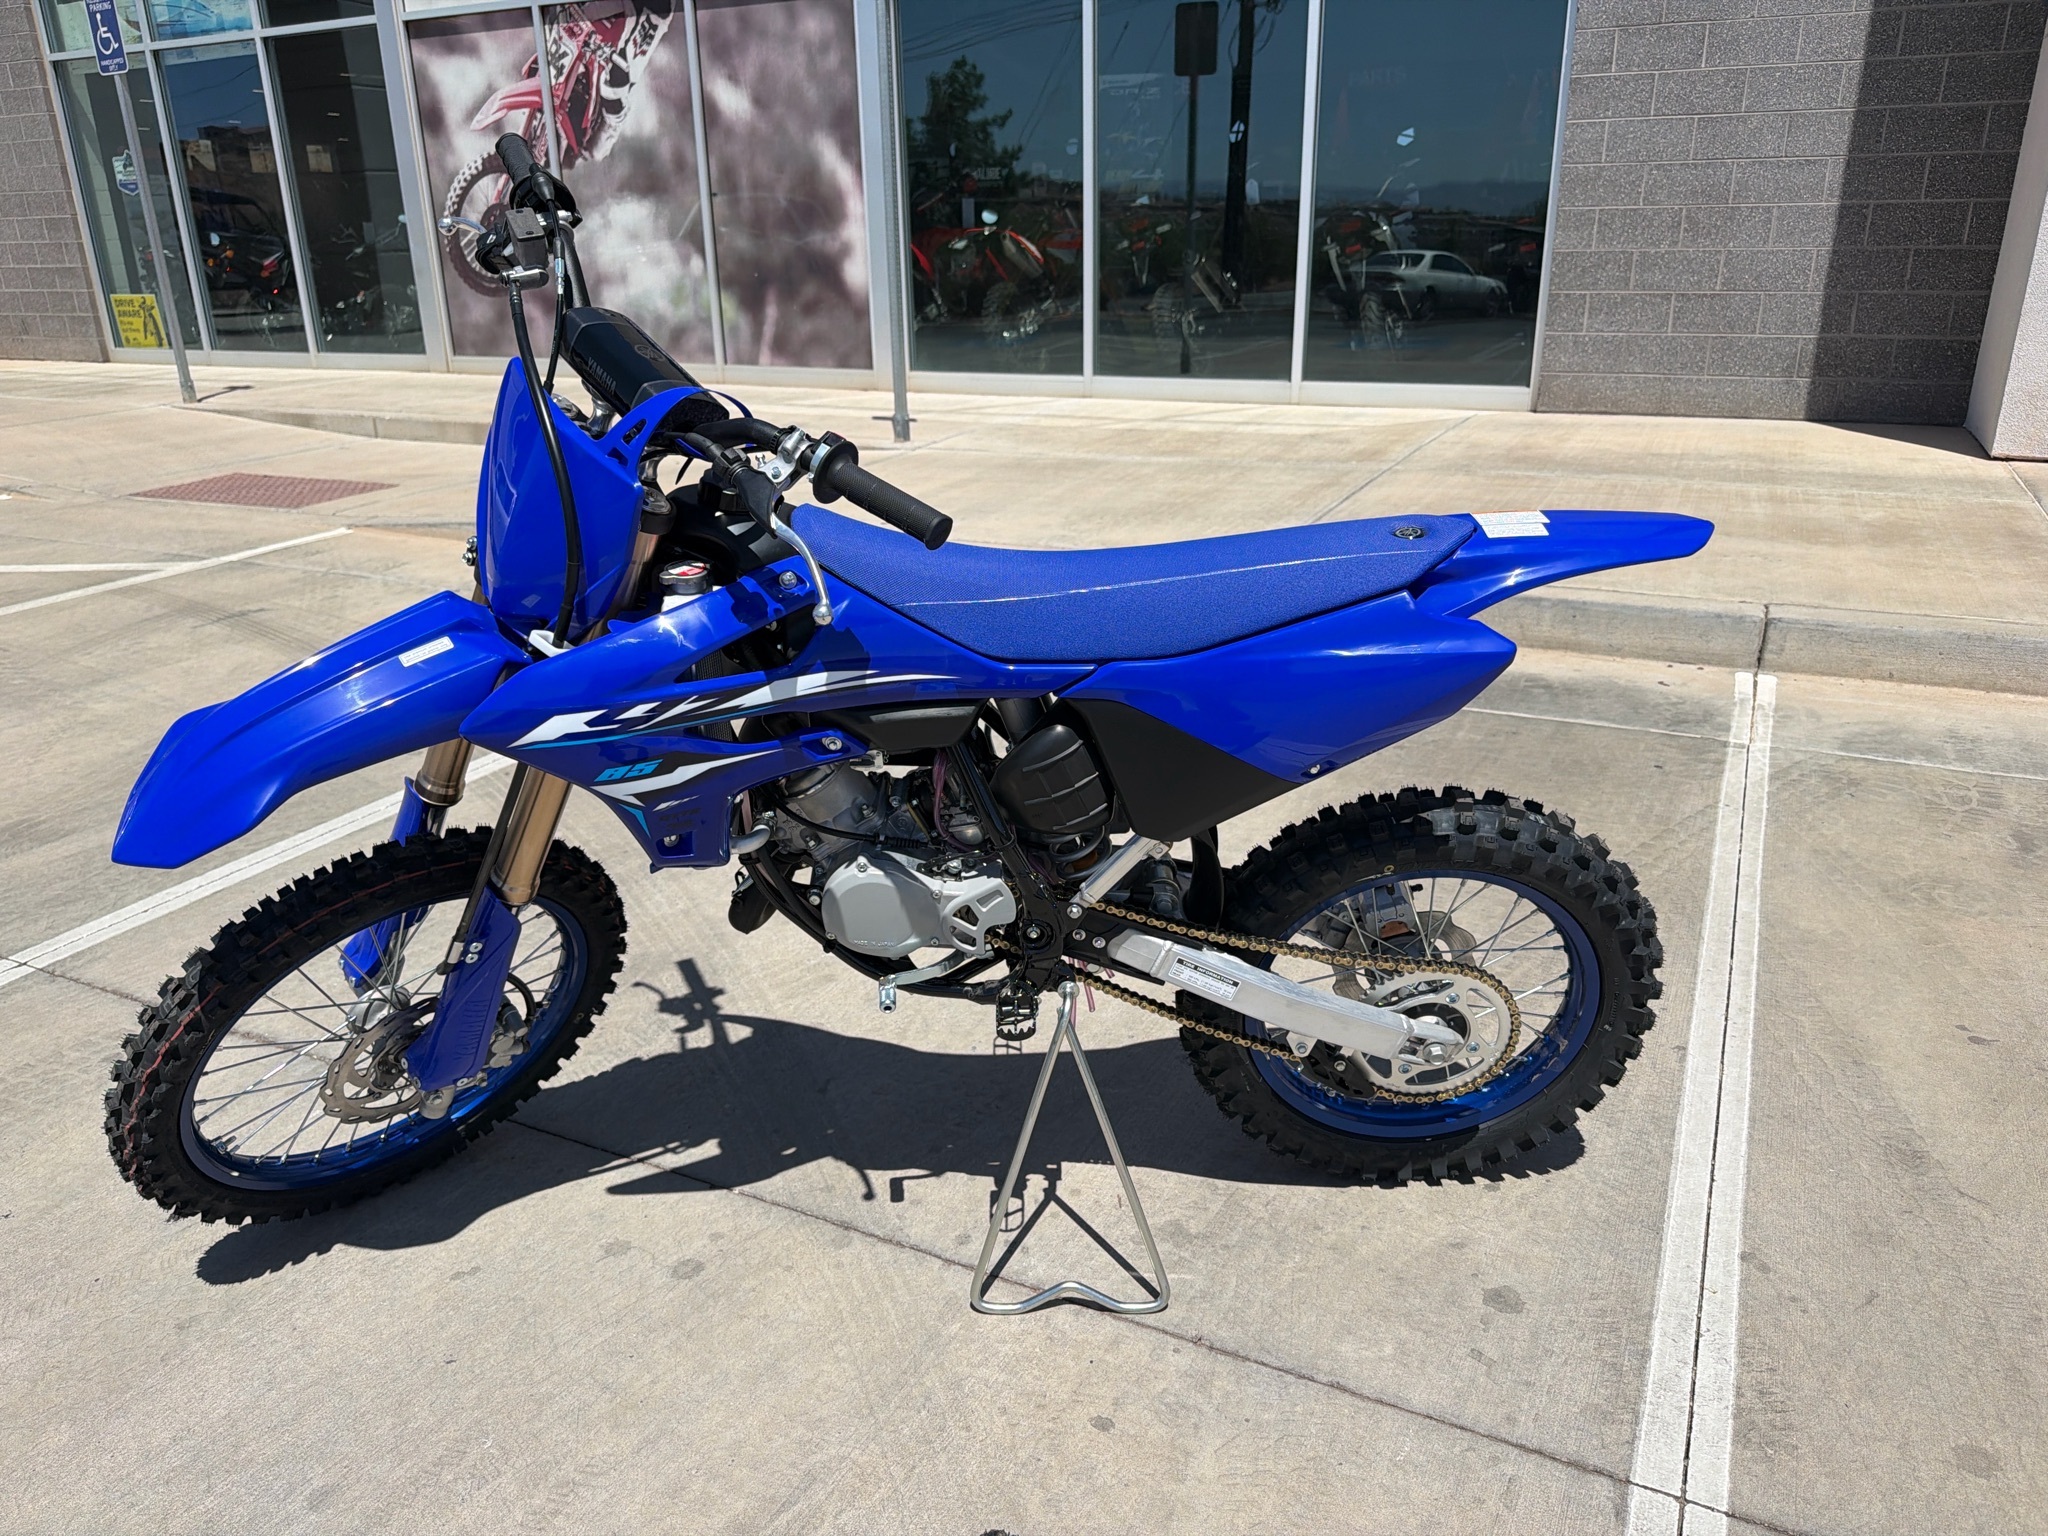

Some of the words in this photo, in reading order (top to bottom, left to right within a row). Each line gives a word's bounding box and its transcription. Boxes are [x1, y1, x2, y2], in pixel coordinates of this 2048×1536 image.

[89, 1, 111, 12] PARKING
[114, 299, 136, 308] DRIVE
[117, 309, 142, 318] AWARE
[587, 356, 617, 396] YAMAHA
[594, 759, 664, 782] 85
[1183, 961, 1195, 969] TIRE
[1197, 966, 1234, 985] INFORMATION
